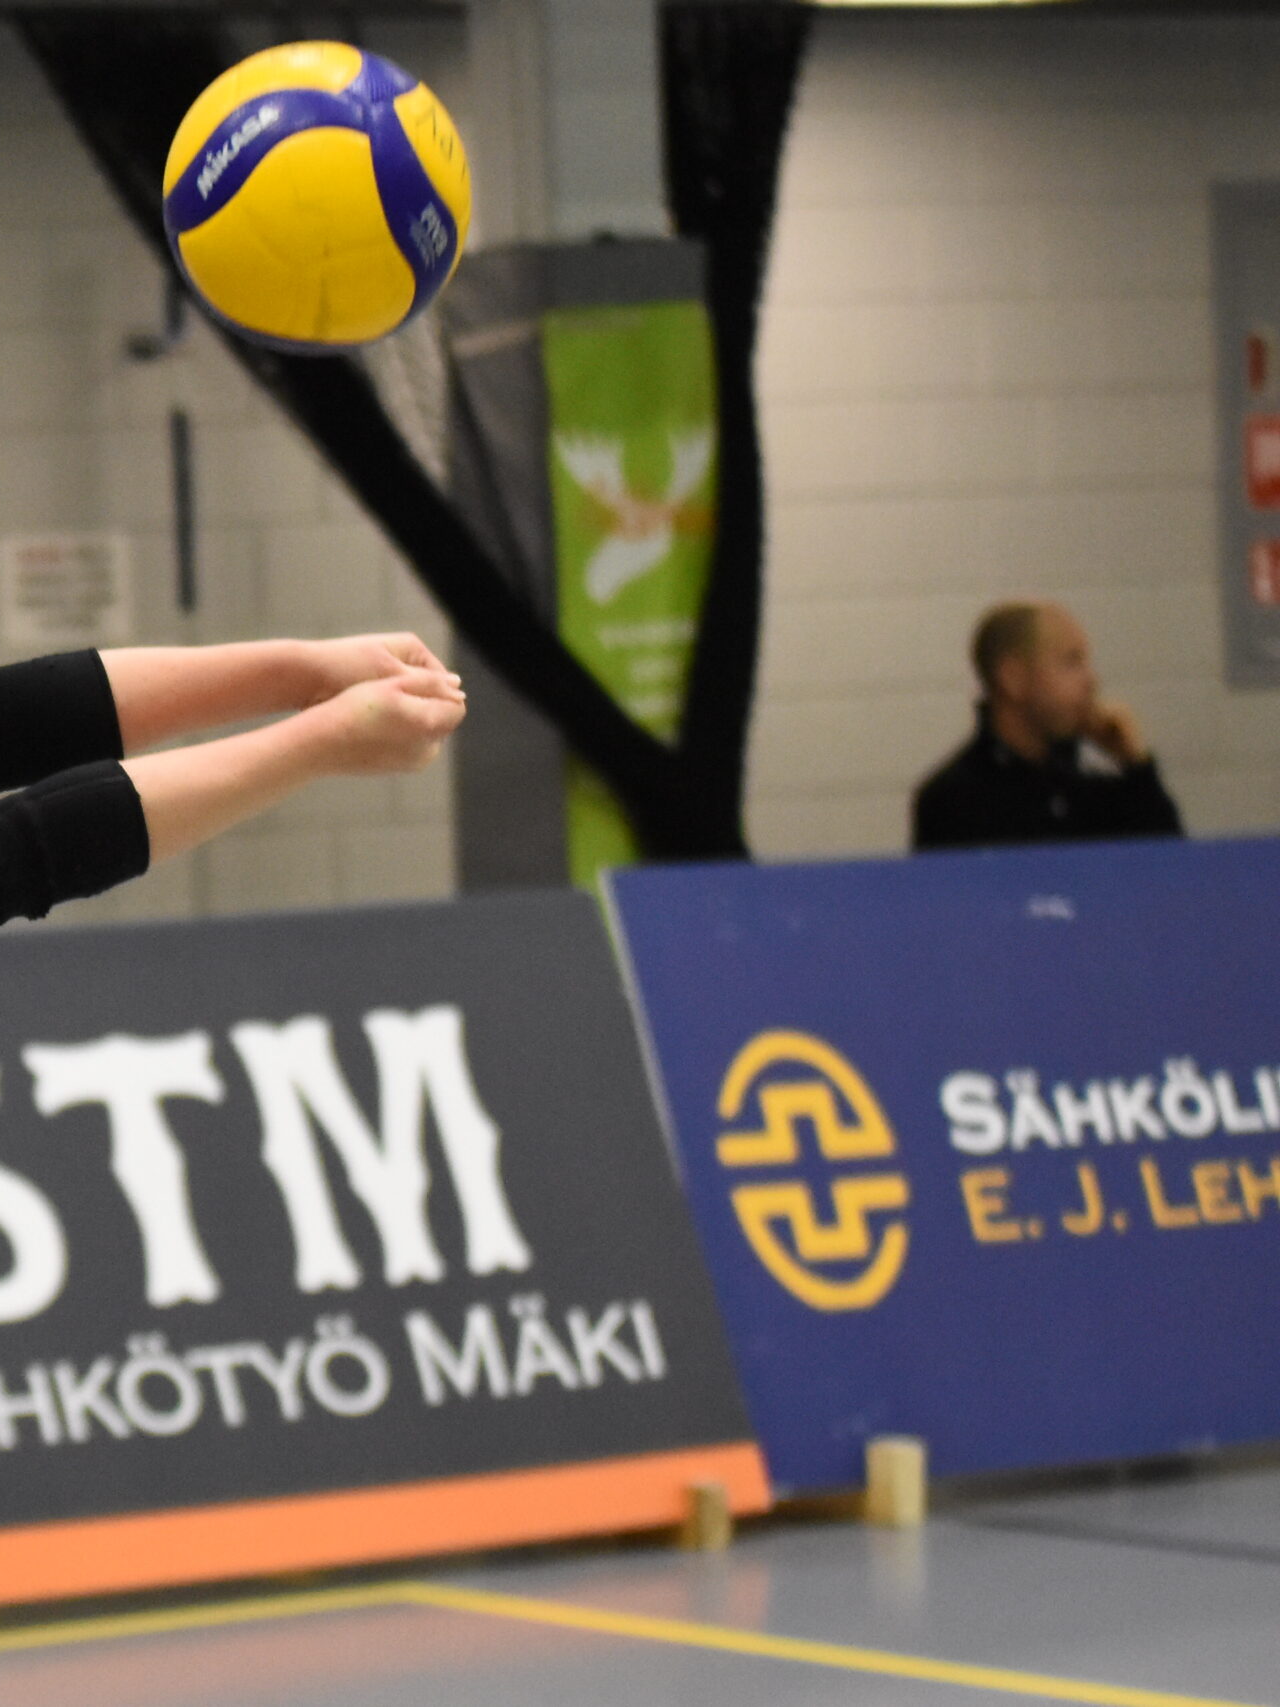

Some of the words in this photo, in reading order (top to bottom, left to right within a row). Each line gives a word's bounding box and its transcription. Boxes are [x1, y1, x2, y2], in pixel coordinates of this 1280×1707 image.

[939, 1056, 1280, 1156] SÄHKÖLI
[960, 1165, 1043, 1244] E.
[1061, 1161, 1128, 1237] J.
[404, 1293, 667, 1406] MÄKI
